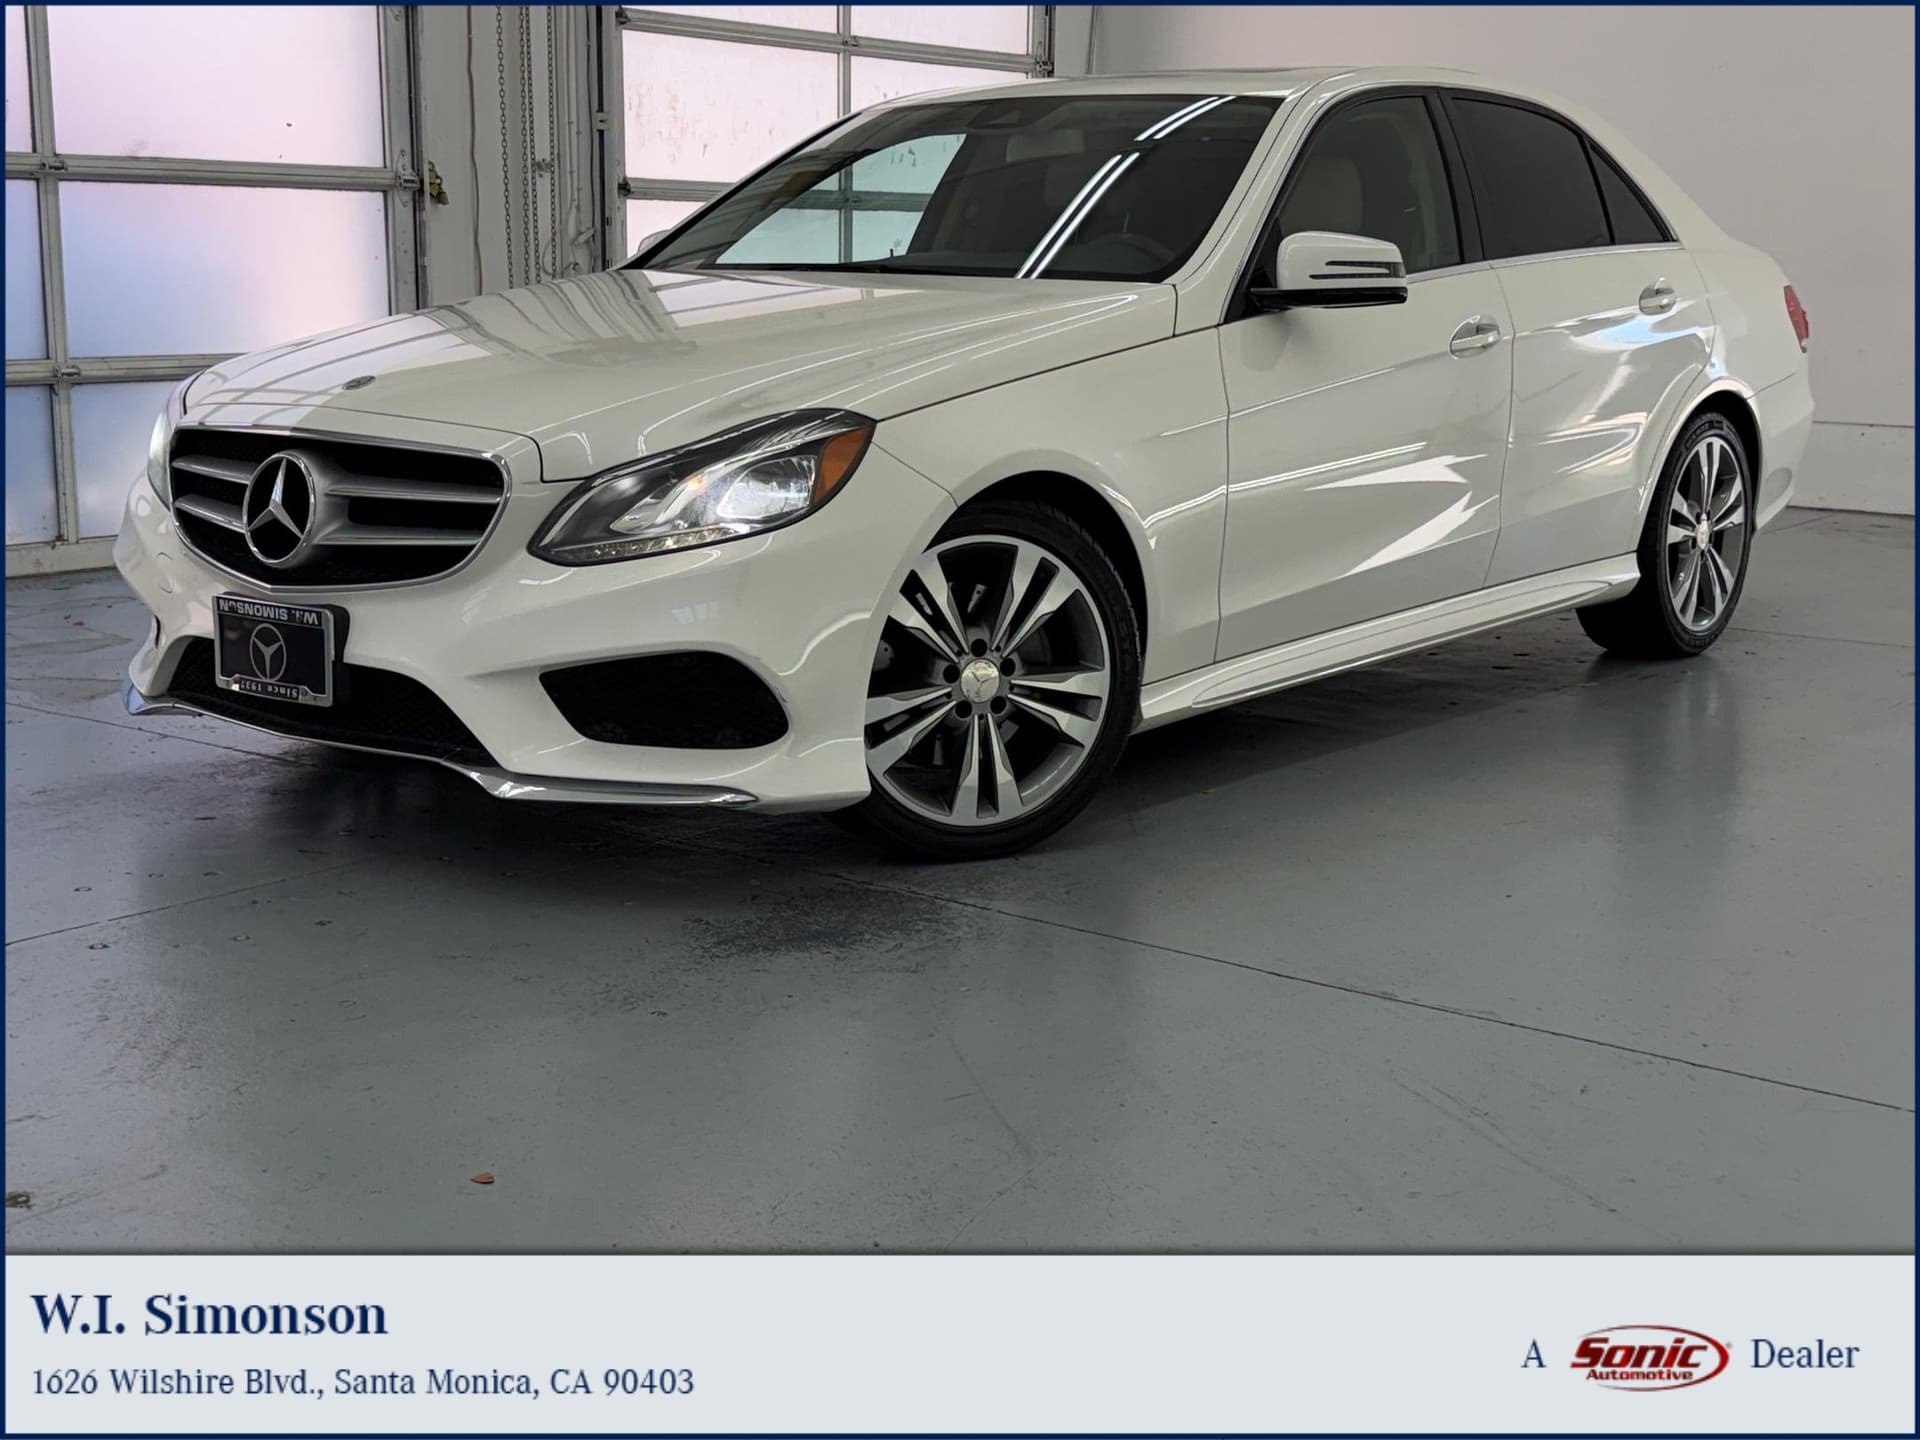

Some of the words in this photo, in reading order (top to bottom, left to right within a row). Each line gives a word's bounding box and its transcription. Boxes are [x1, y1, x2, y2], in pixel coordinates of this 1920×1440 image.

[219, 598, 288, 621] SIMONSON
[290, 607, 319, 625] W.I.
[240, 679, 262, 691] 1937
[266, 685, 298, 698] Since
